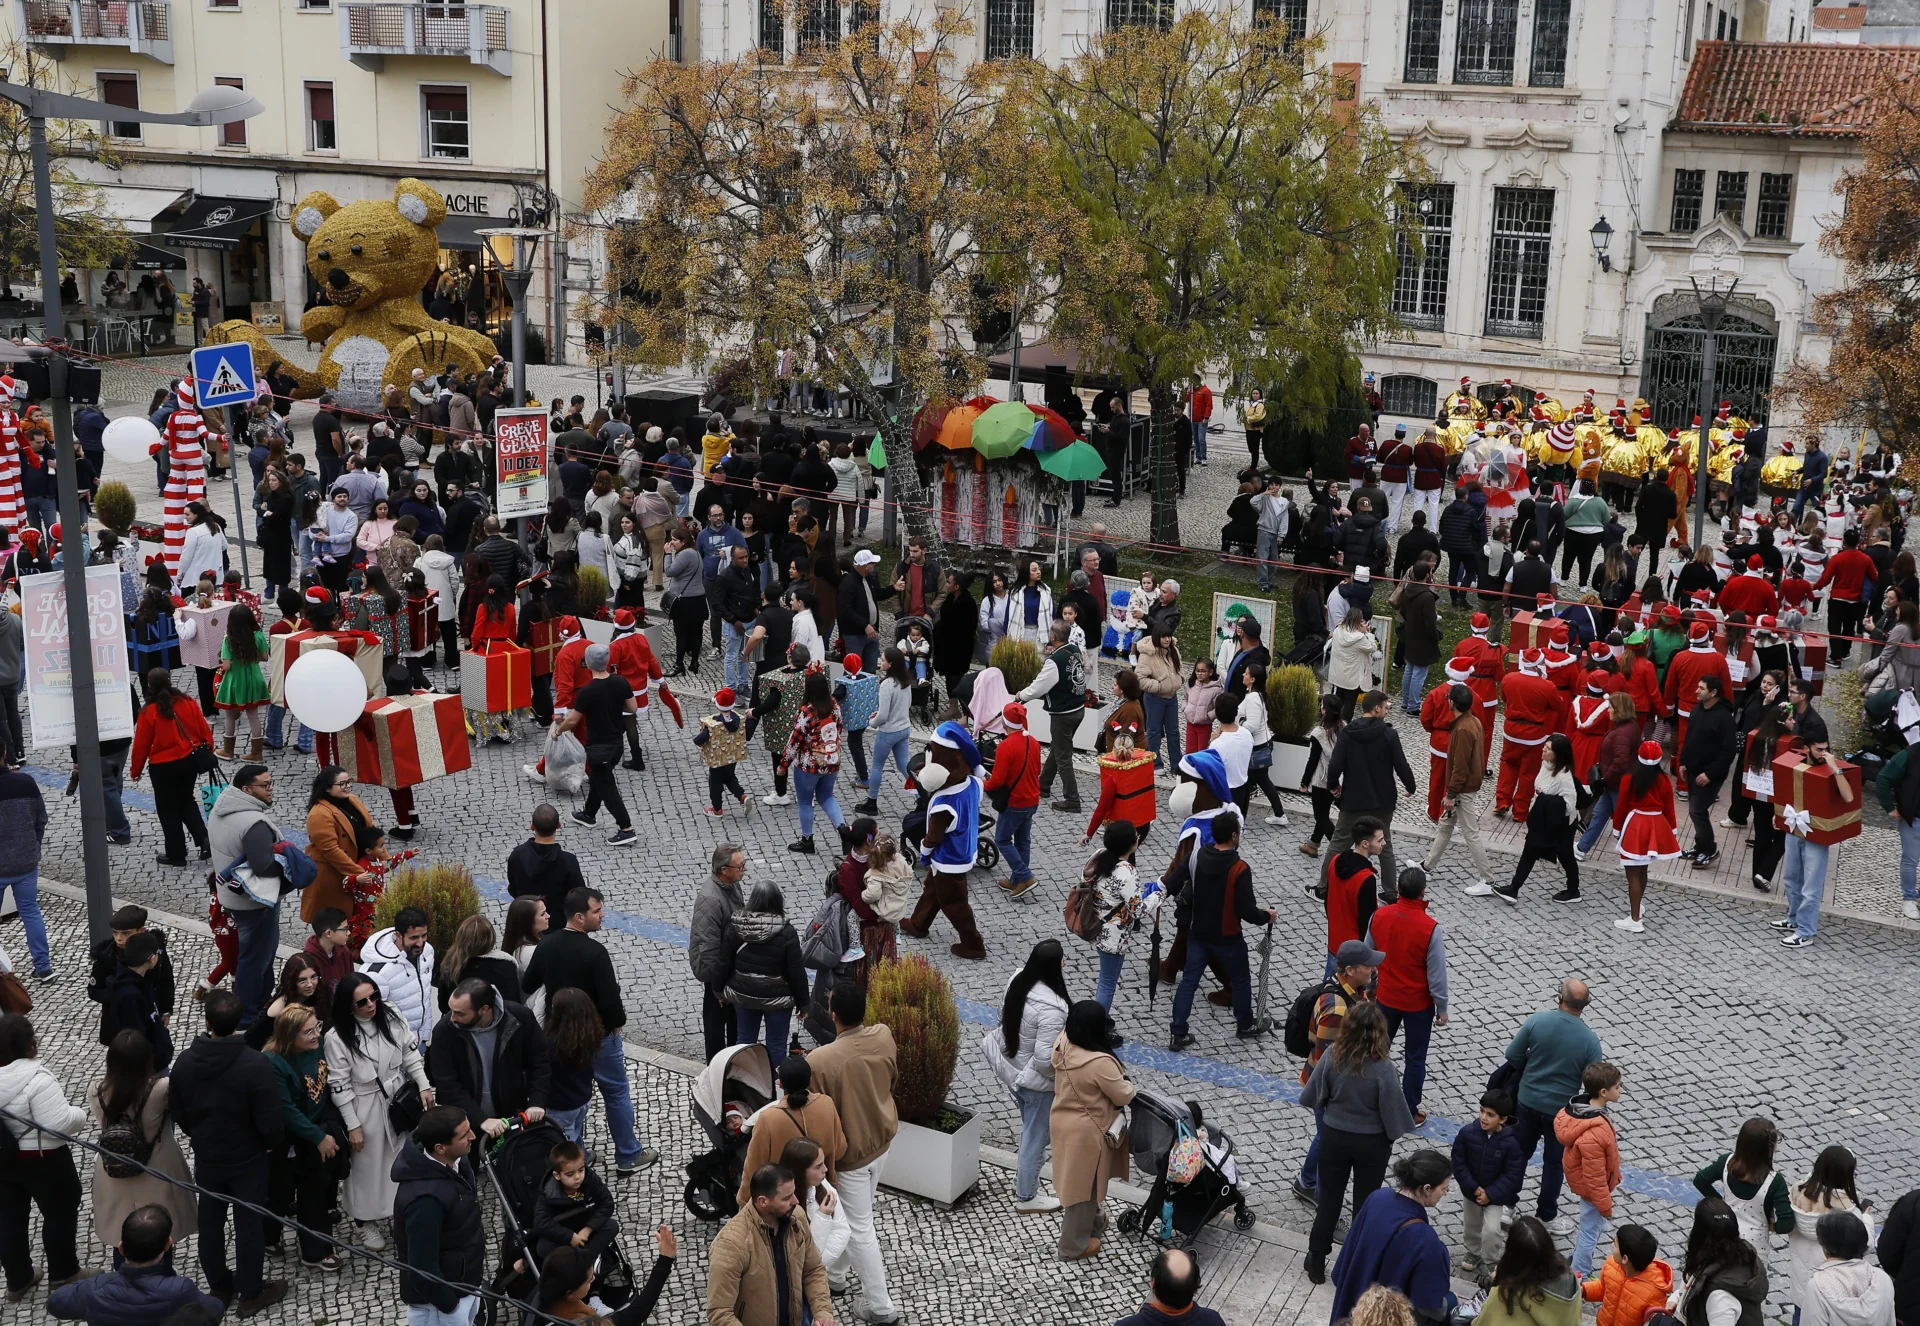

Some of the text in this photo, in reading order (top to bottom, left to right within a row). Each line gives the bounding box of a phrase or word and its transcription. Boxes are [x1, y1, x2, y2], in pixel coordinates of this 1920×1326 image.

[439, 194, 489, 214] ACHE
[499, 420, 542, 439] GREVE
[500, 433, 545, 454] GERAL
[502, 456, 543, 472] 11 DEZ.
